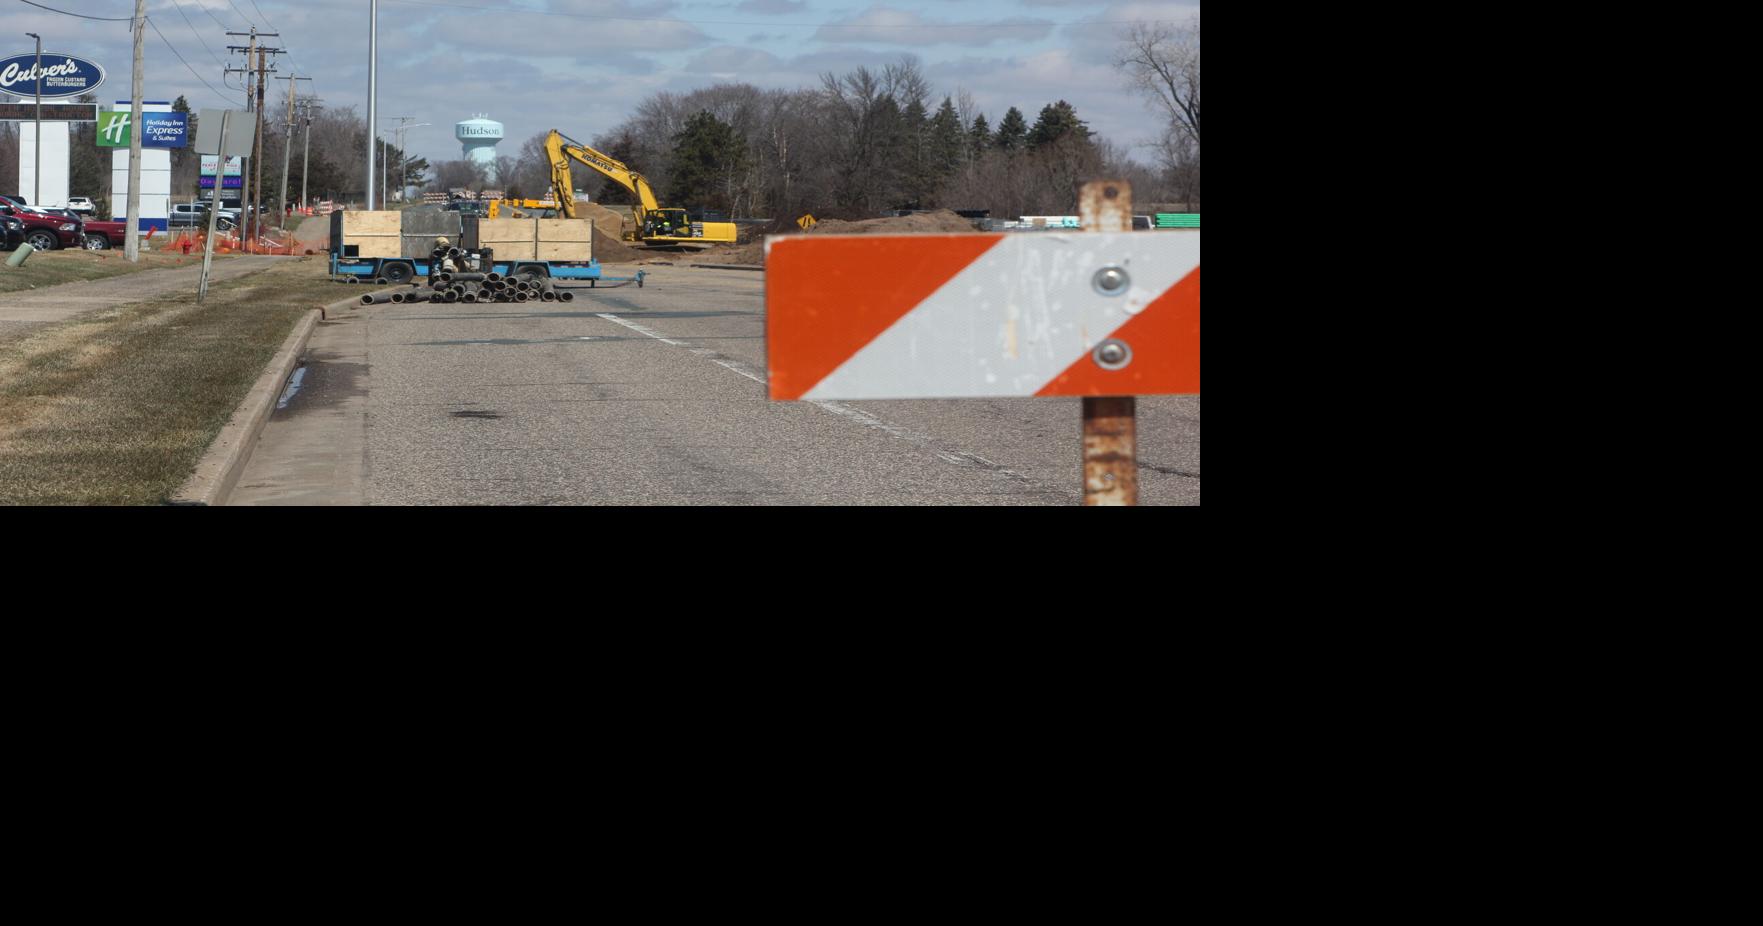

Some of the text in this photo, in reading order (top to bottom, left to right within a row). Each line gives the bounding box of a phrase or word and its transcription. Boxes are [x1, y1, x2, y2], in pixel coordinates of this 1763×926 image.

[0, 58, 77, 86] Culver's
[146, 119, 172, 127] Holiday
[146, 126, 184, 135] Express
[461, 126, 500, 135] Hudson
[581, 154, 612, 171] KOMATSU
